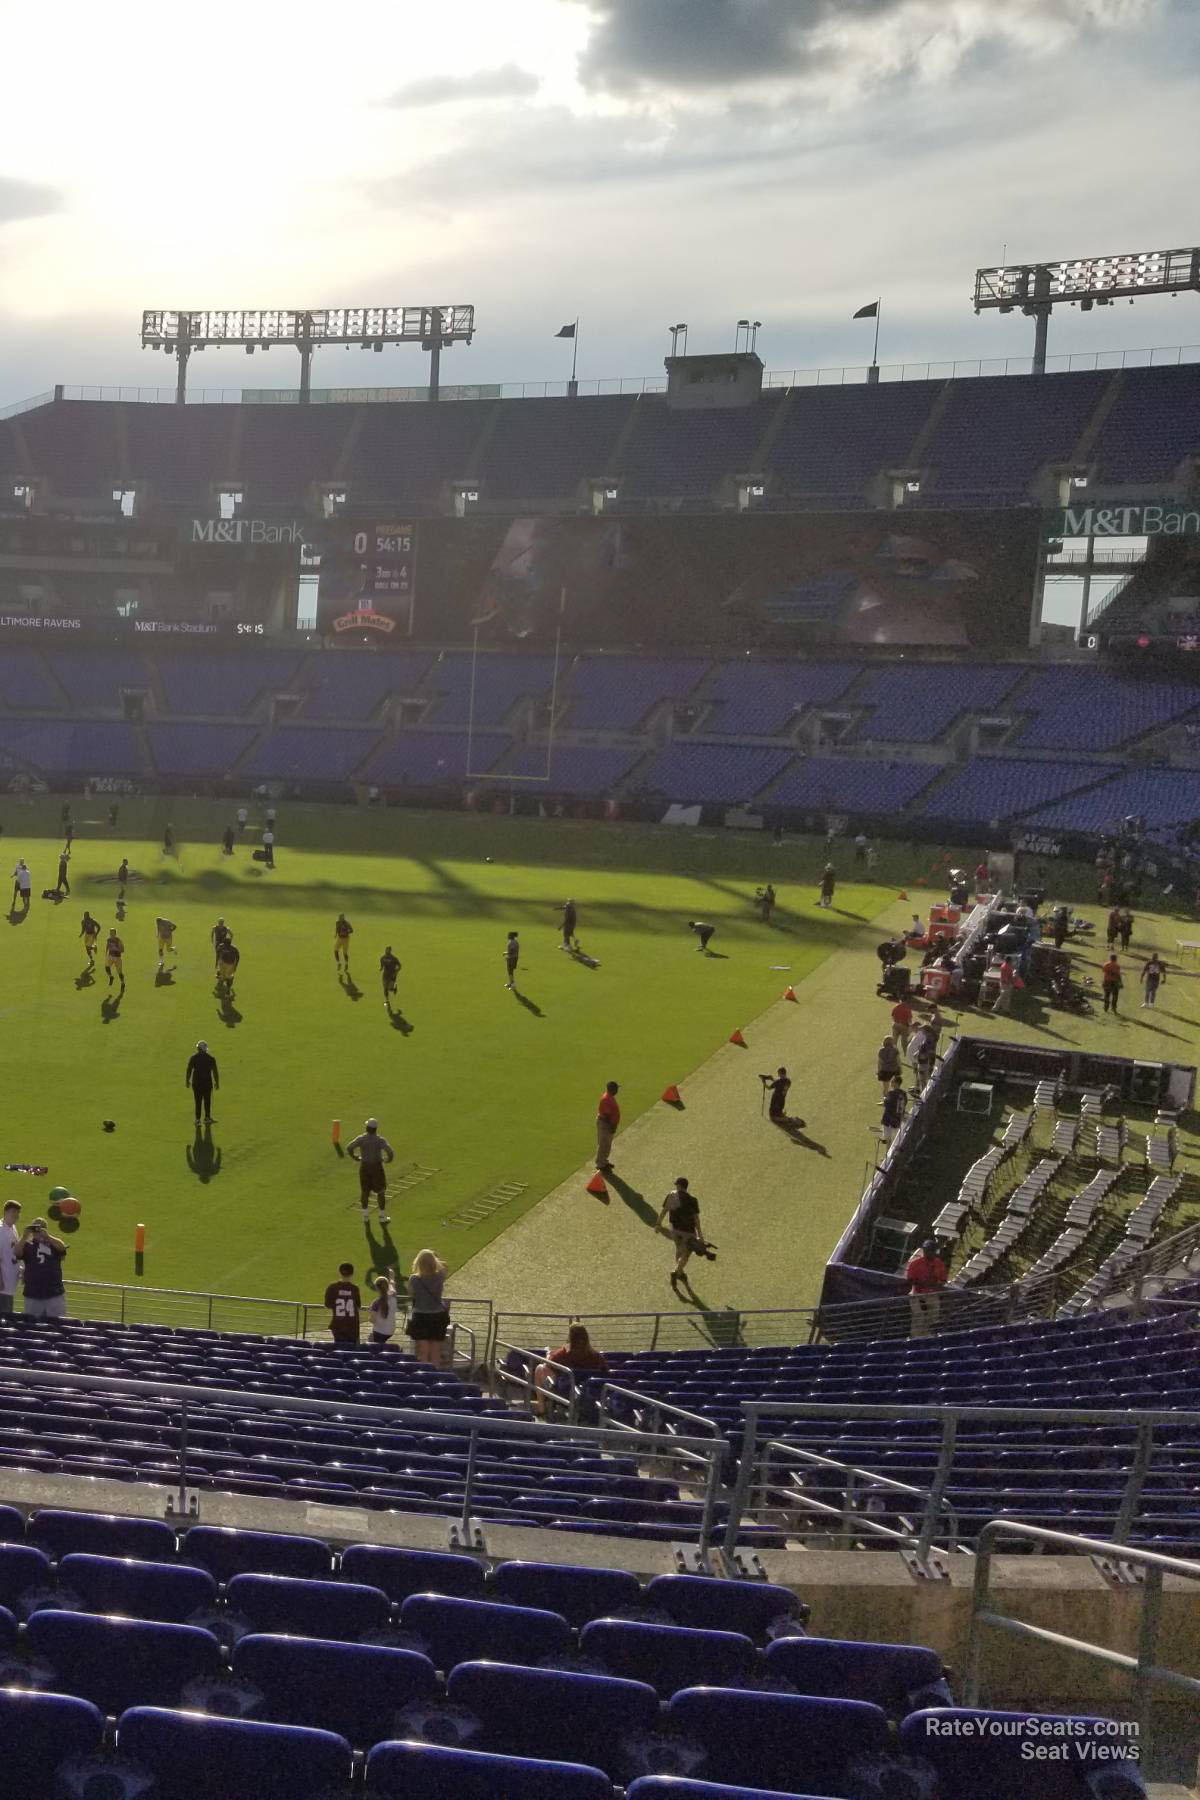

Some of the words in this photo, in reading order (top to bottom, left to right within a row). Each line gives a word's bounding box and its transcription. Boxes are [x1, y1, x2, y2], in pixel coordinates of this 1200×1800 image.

[1062, 507, 1140, 535] M&T
[192, 519, 248, 542] M&T
[251, 519, 305, 543] Bank
[354, 531, 368, 554] 0
[376, 537, 410, 552] 54:15
[43, 618, 81, 629] RAVENS
[135, 621, 158, 632] M&T
[158, 621, 181, 632] Bank
[181, 622, 217, 633] Stadium
[236, 623, 264, 634] 54:15
[1087, 636, 1096, 648] 0
[335, 1298, 355, 1317] 24
